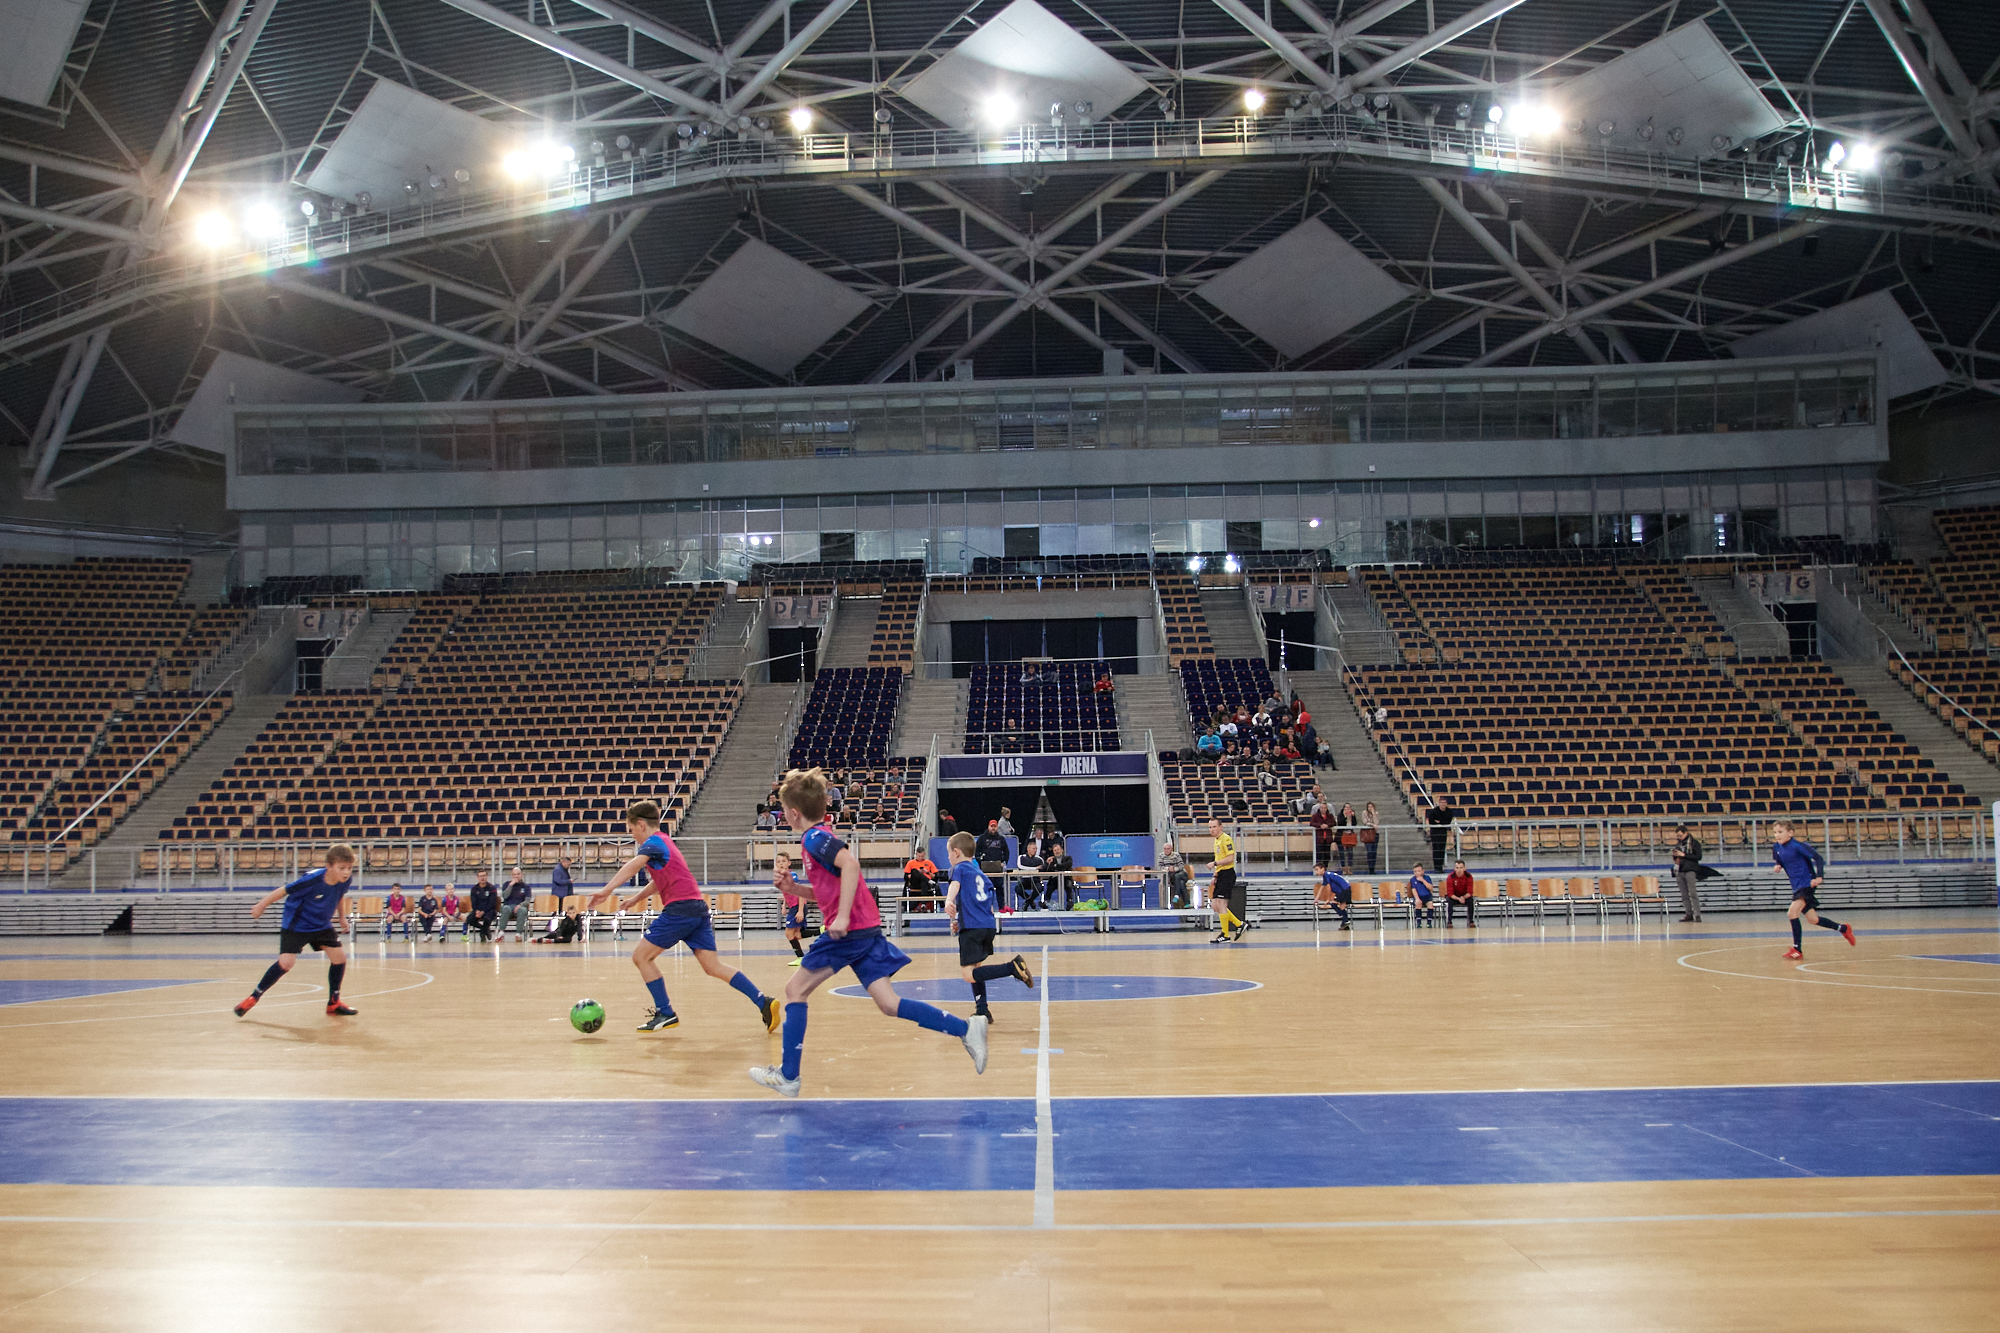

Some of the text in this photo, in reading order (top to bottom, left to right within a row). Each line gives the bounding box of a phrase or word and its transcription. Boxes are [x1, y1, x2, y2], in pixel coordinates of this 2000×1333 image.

[1796, 576, 1810, 590] G
[1298, 589, 1308, 603] F
[774, 601, 787, 615] D
[817, 600, 828, 614] E
[303, 614, 315, 628] C
[987, 757, 1098, 776] ATLAS ARENA
[975, 874, 988, 902] 3
